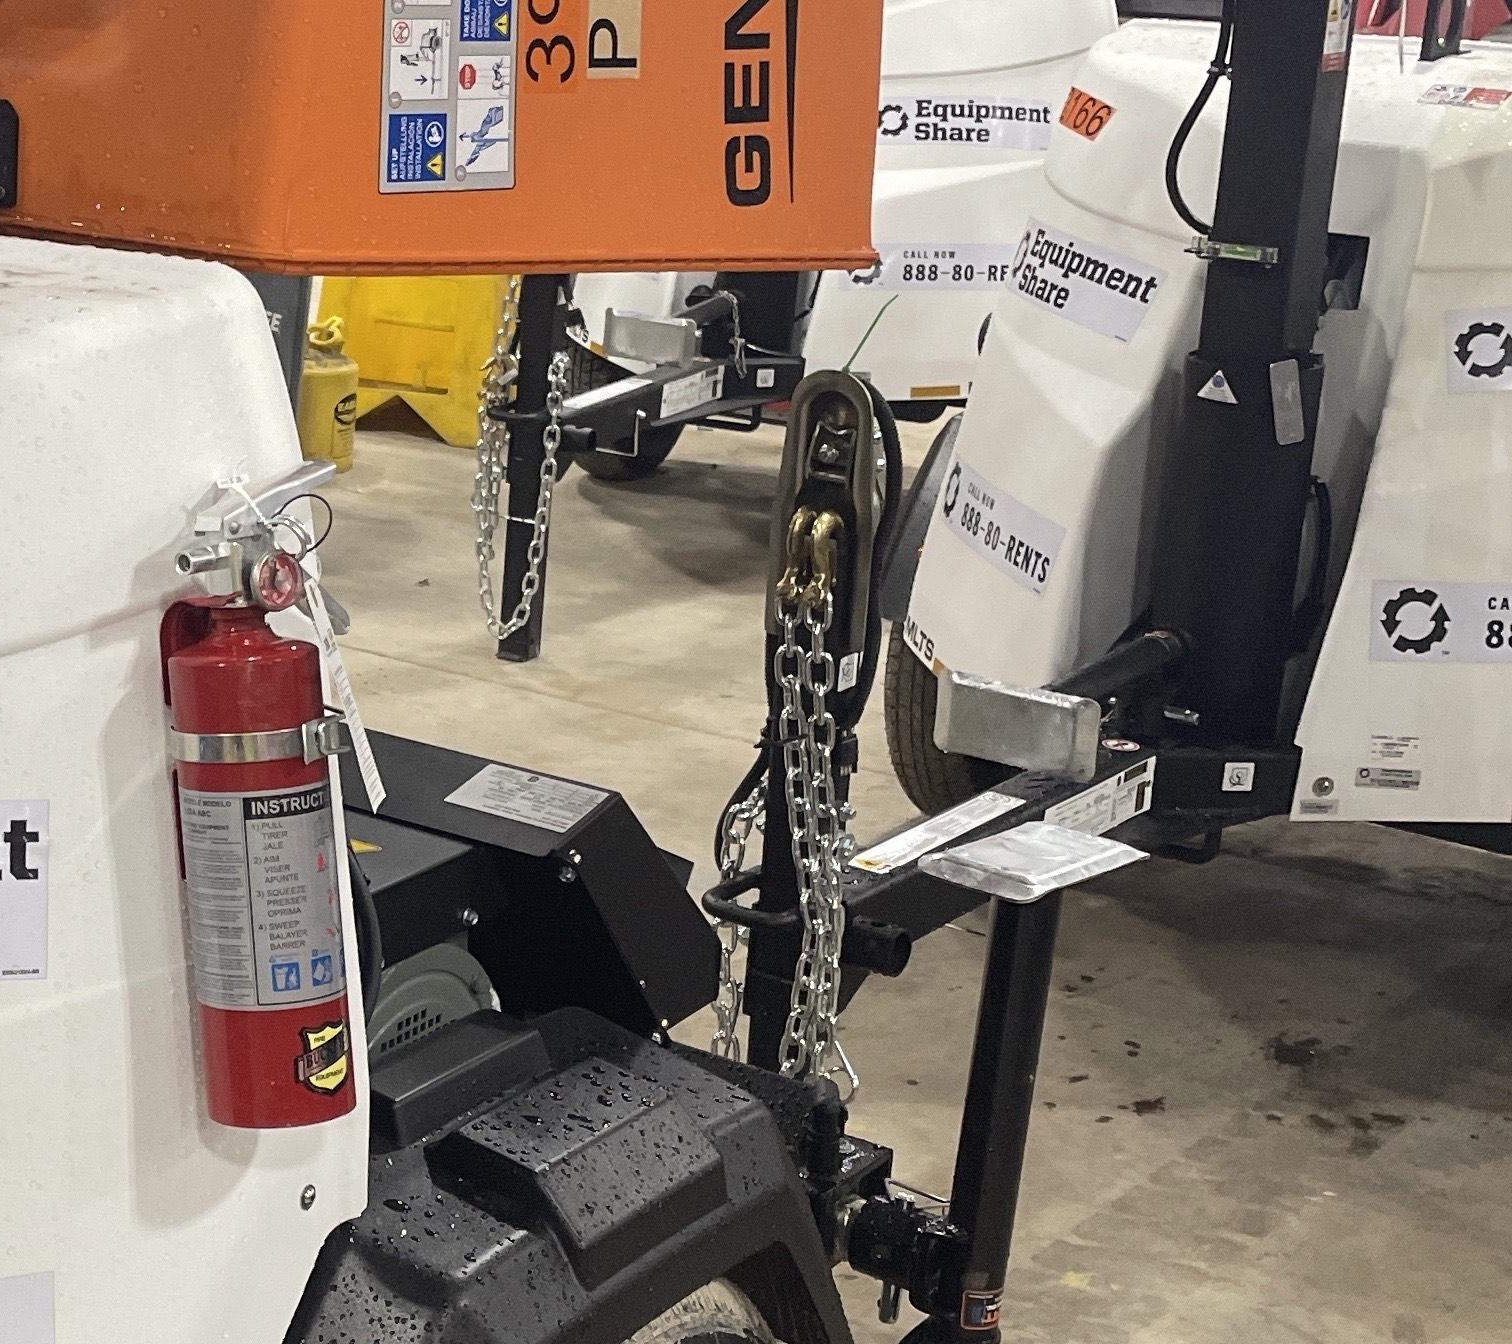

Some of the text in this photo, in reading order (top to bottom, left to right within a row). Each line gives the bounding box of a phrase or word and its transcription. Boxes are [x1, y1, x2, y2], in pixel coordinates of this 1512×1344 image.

[915, 99, 1051, 123] Equipment
[914, 123, 990, 142] Share
[414, 118, 423, 179] INSTALLATION
[903, 251, 928, 259] CALL
[1029, 228, 1158, 304] Equipment
[1018, 263, 1070, 309] Share
[960, 503, 1050, 583] 888-80-RENTS
[1486, 620, 1512, 649] 8
[261, 822, 283, 830] PULL
[262, 831, 288, 840] TIRER
[263, 841, 284, 850] JALE
[264, 874, 299, 883] APUNTE
[267, 886, 307, 897] SQUEEZE
[269, 921, 300, 931] SWEEP
[269, 930, 308, 940] BALAYER
[270, 940, 306, 950] BARRER
